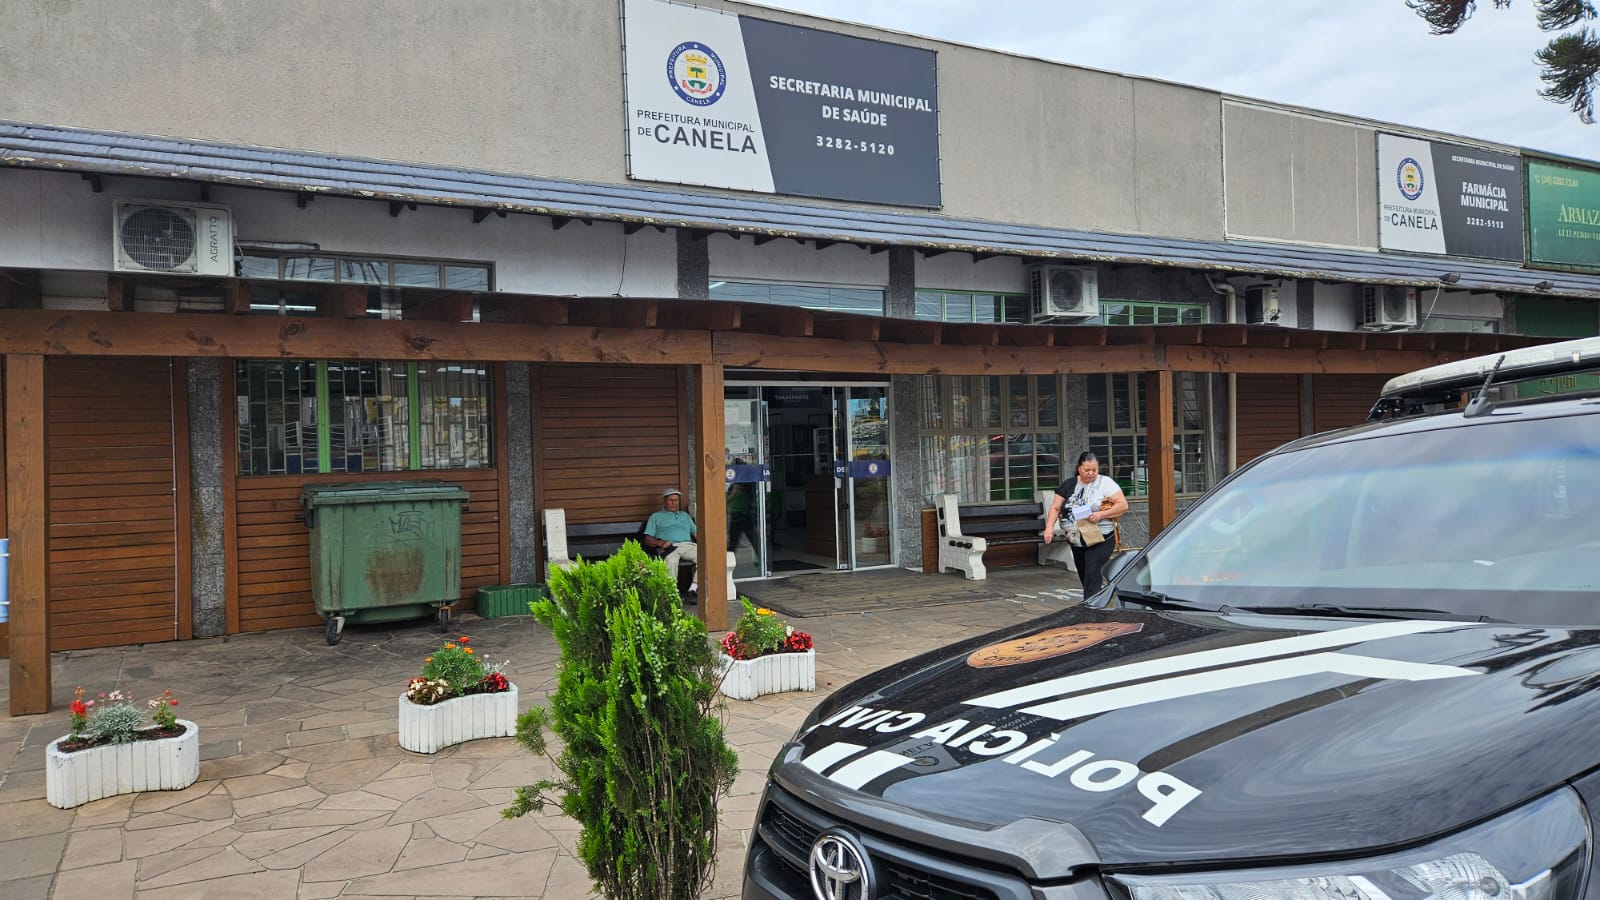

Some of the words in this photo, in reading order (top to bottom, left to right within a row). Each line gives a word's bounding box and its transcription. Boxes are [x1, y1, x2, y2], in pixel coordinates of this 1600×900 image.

[686, 96, 711, 105] CANELA
[769, 75, 855, 101] SECRETARIA
[857, 89, 932, 112] MUNICIPAL
[637, 109, 701, 126] PREFEITURA
[703, 118, 756, 133] MUNICIPAL
[822, 105, 840, 120] DE
[843, 108, 888, 126] SAÚDE
[637, 126, 652, 136] DE
[654, 124, 757, 154] CANELA
[816, 135, 895, 155] 3282-5120
[1462, 181, 1507, 199] FARMÁCIA
[1460, 194, 1509, 212] MUNICIPAL
[1391, 213, 1438, 230] CANELA
[209, 216, 218, 262] AGRATTO
